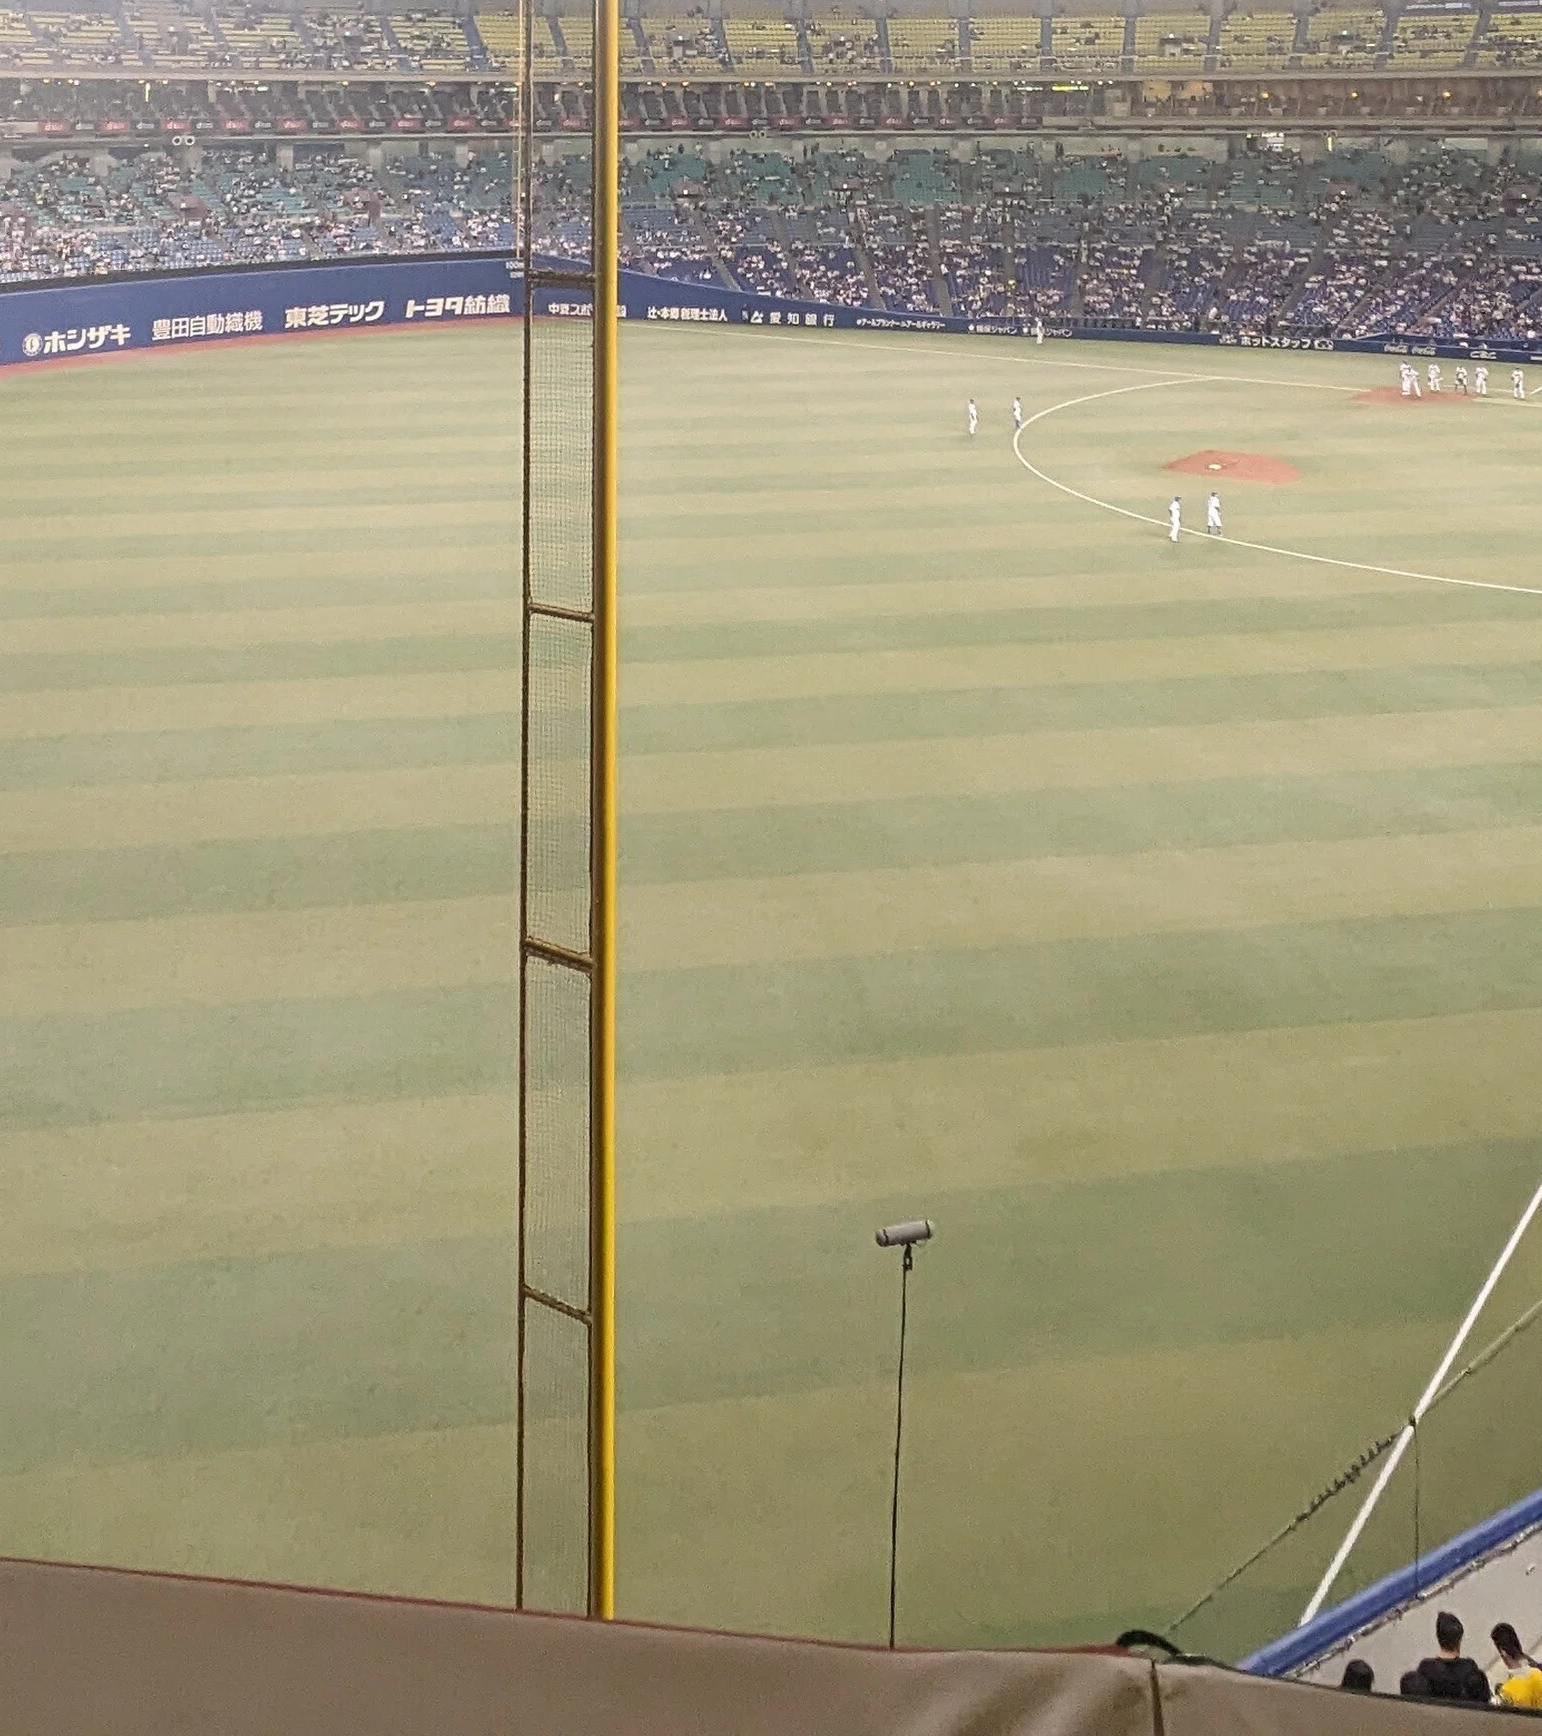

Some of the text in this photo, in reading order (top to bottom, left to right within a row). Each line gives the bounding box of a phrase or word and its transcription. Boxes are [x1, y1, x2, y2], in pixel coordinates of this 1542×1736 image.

[284, 300, 386, 330] 東芝テック
[404, 293, 511, 319] トヨタ紡織
[769, 311, 835, 327] 愛知銀行
[43, 323, 131, 354] ホシザキ
[151, 310, 264, 342] 豊田自動織機
